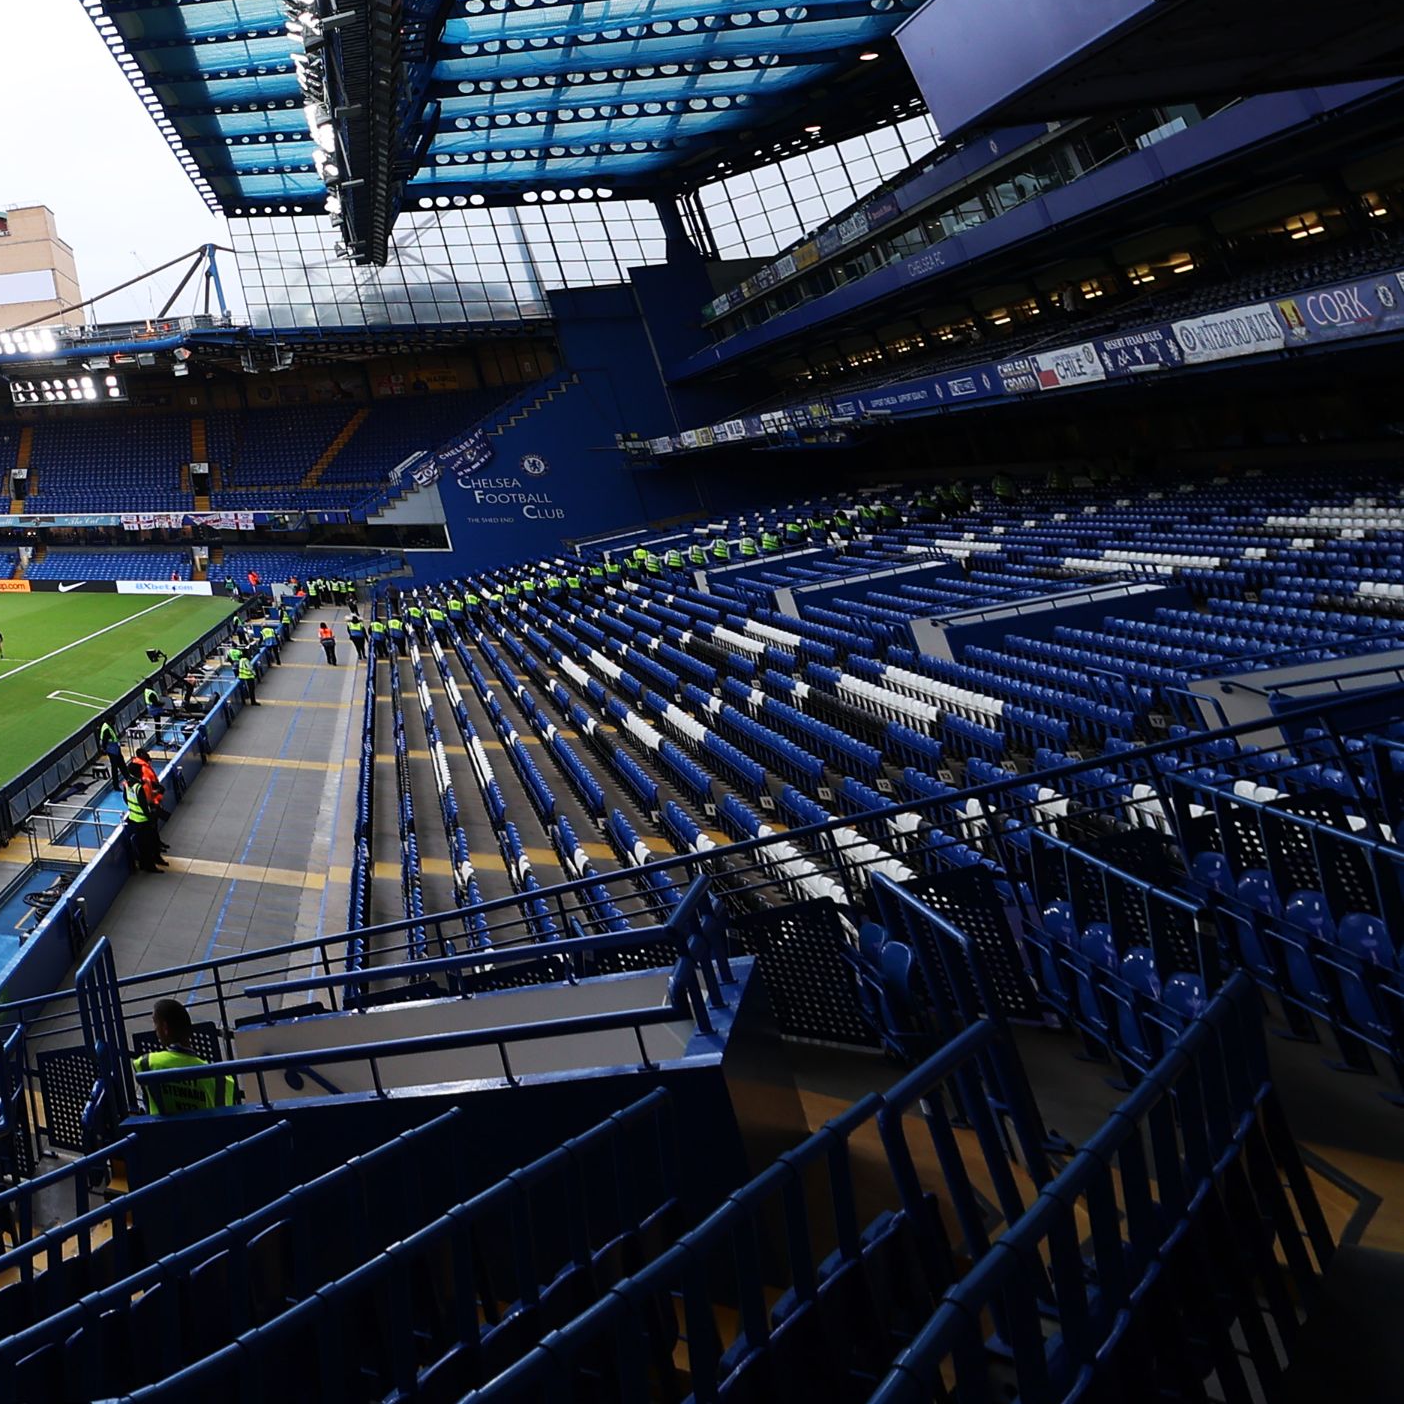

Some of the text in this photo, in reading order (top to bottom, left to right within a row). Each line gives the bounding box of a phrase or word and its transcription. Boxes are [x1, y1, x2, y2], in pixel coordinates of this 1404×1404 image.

[908, 251, 945, 276] CHELSEA FC
[1308, 287, 1372, 325] CORK
[1246, 311, 1280, 341] BLUES
[997, 359, 1032, 375] CHELSEA
[1055, 359, 1087, 379] CHILE
[1004, 375, 1036, 391] CROATIA
[439, 428, 484, 460] CHELSEA FC
[458, 478, 522, 489] CHELSEA
[474, 490, 552, 503] FOOTBALL
[523, 505, 565, 519] CLUB
